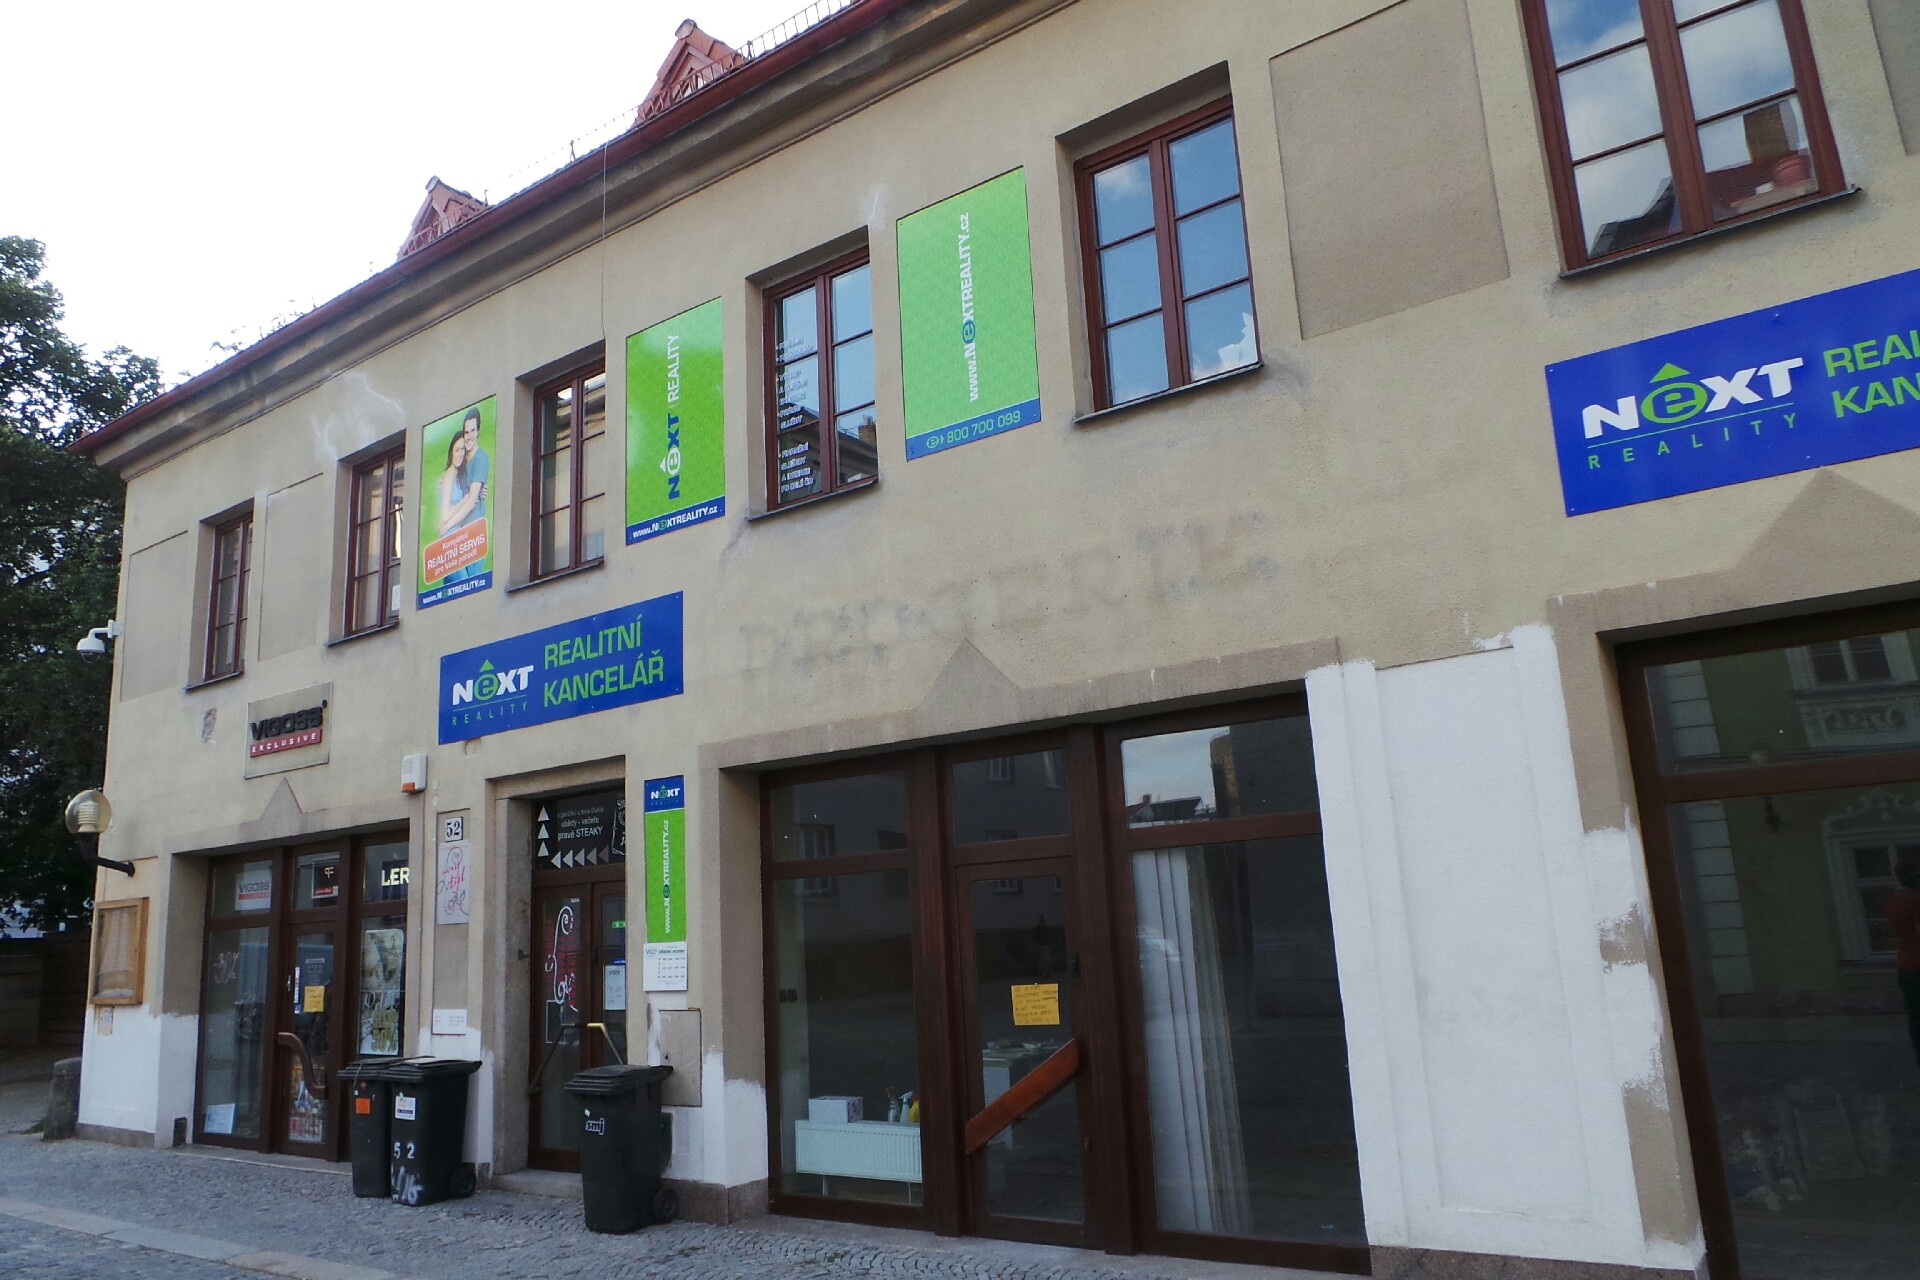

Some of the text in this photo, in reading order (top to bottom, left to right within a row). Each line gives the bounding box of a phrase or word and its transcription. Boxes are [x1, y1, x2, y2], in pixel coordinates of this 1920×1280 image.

[668, 335, 679, 403] REALITY
[947, 426, 969, 444] 800
[971, 418, 994, 435] 700
[997, 410, 1021, 428] 099
[1588, 412, 1796, 469] REALITY
[459, 533, 485, 554] SERVIS
[434, 566, 445, 577] pro
[544, 614, 642, 670] REALITNÍ
[543, 649, 664, 707] KANCELÁŘ
[250, 705, 324, 741] VIGOSS
[452, 701, 528, 726] REALITY
[252, 732, 316, 753] EXCLUSIVE
[446, 820, 461, 837] 52
[557, 825, 604, 842] pravé STEAKY
[381, 866, 410, 887] LER
